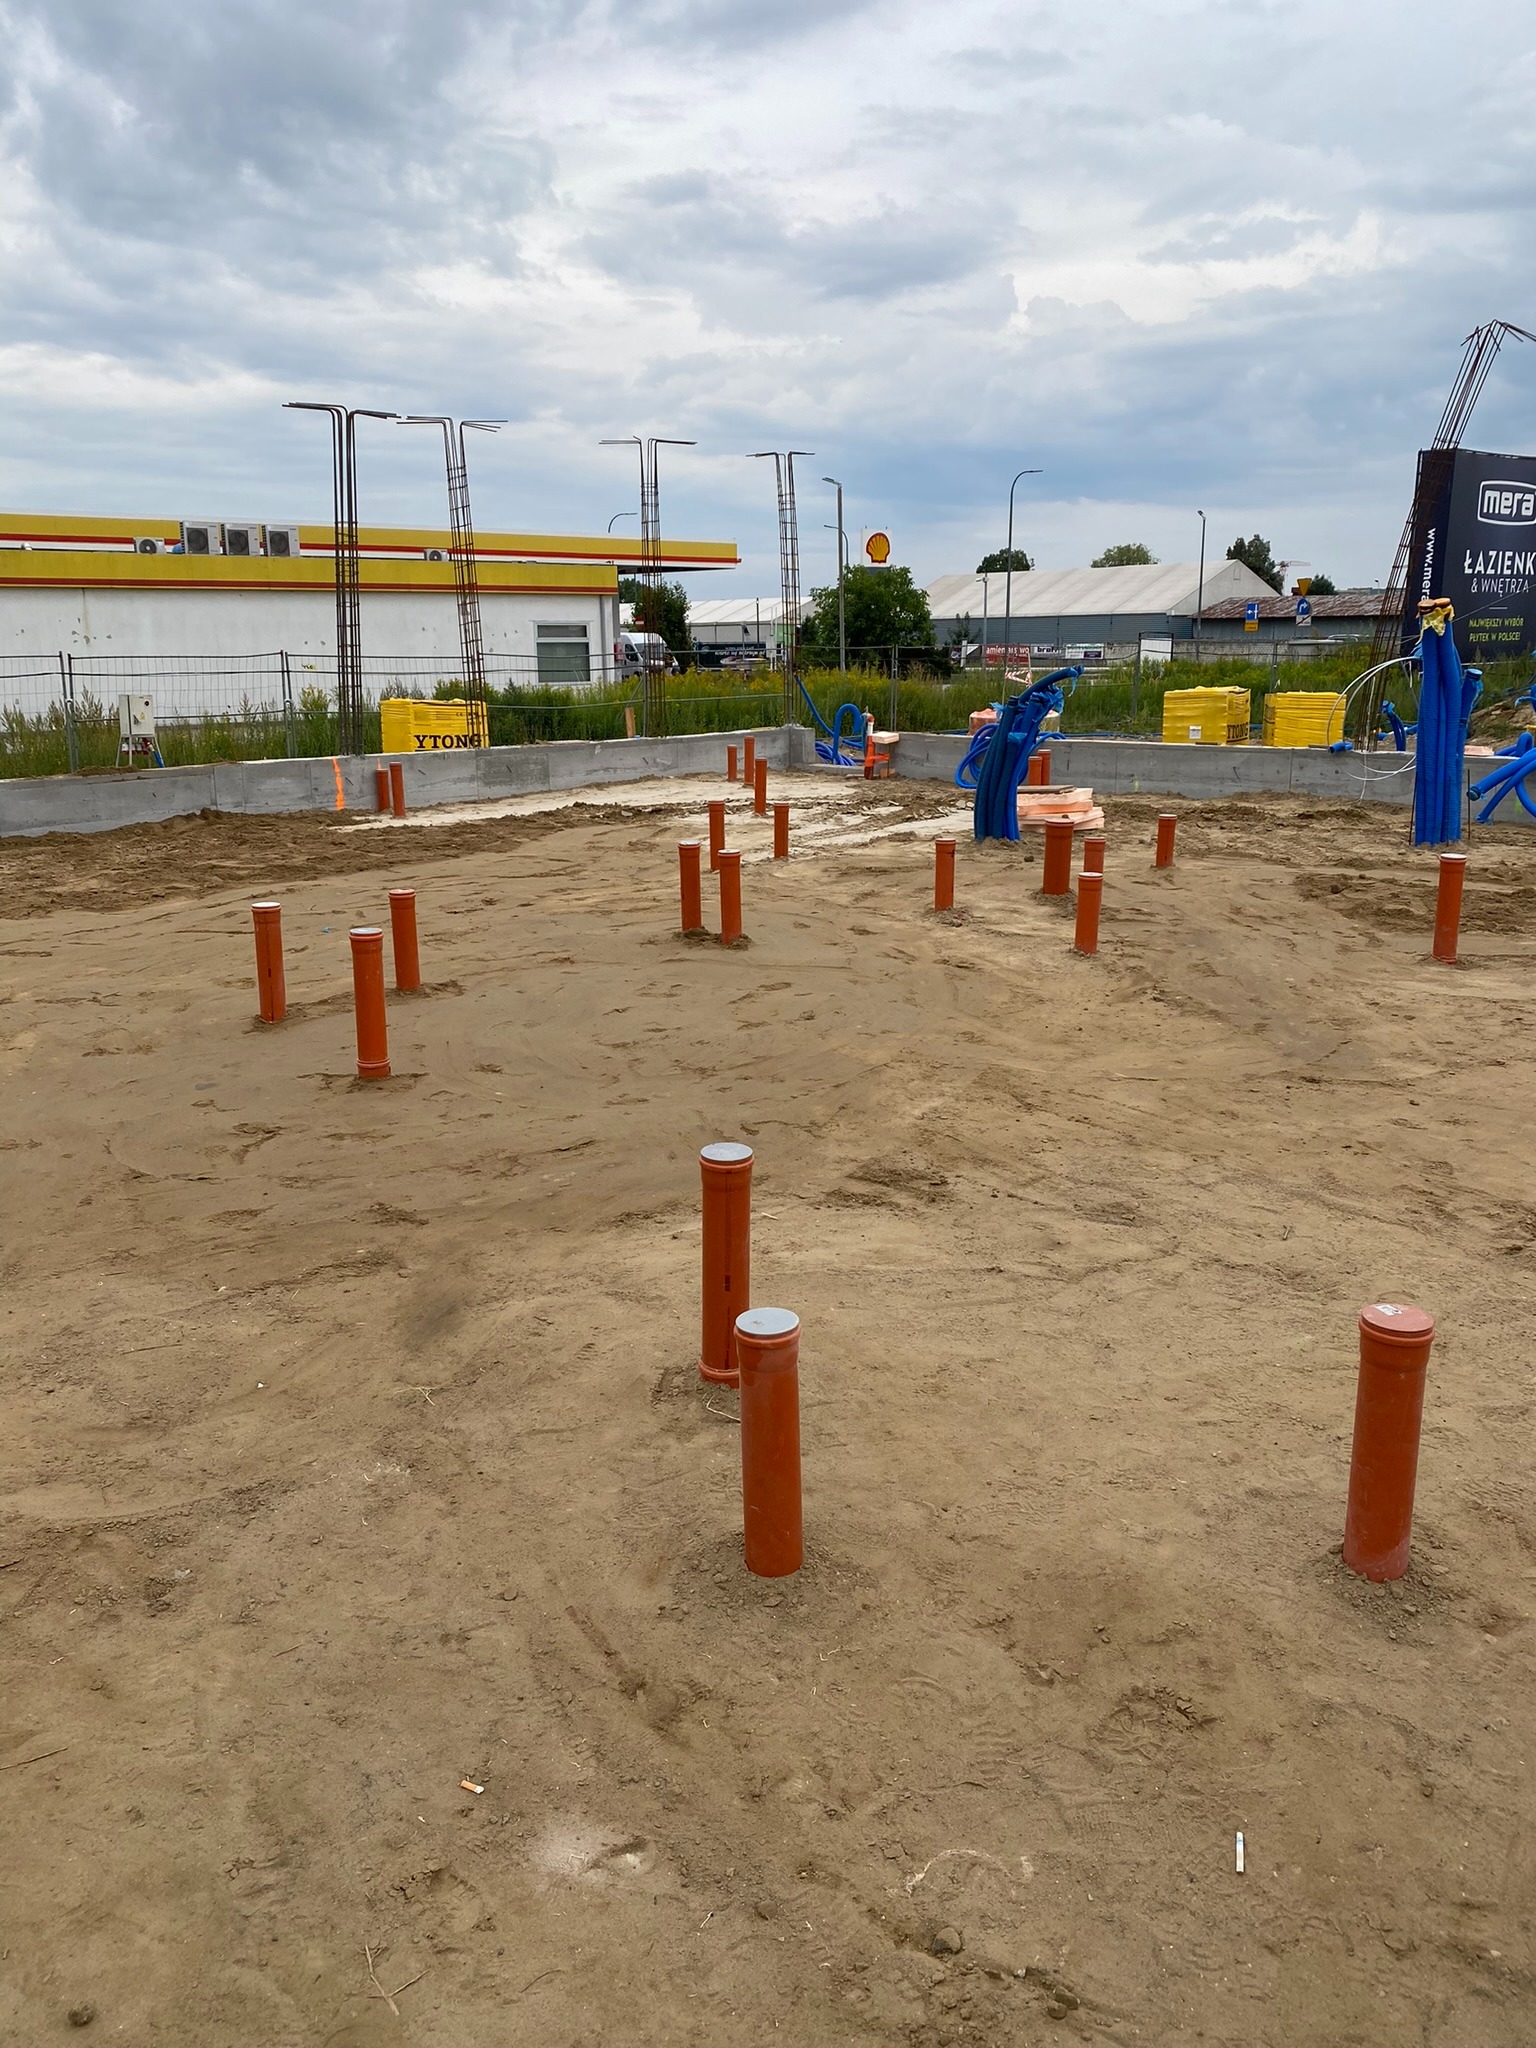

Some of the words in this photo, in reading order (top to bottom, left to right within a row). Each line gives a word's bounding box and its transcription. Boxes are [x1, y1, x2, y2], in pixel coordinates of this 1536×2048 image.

[1483, 490, 1534, 517] mera
[1464, 549, 1536, 575] ŁAZIENK
[1471, 577, 1478, 593] &
[1481, 578, 1529, 598] WNĘTRZA
[1491, 632, 1497, 641] W
[413, 734, 482, 749] YTONG
